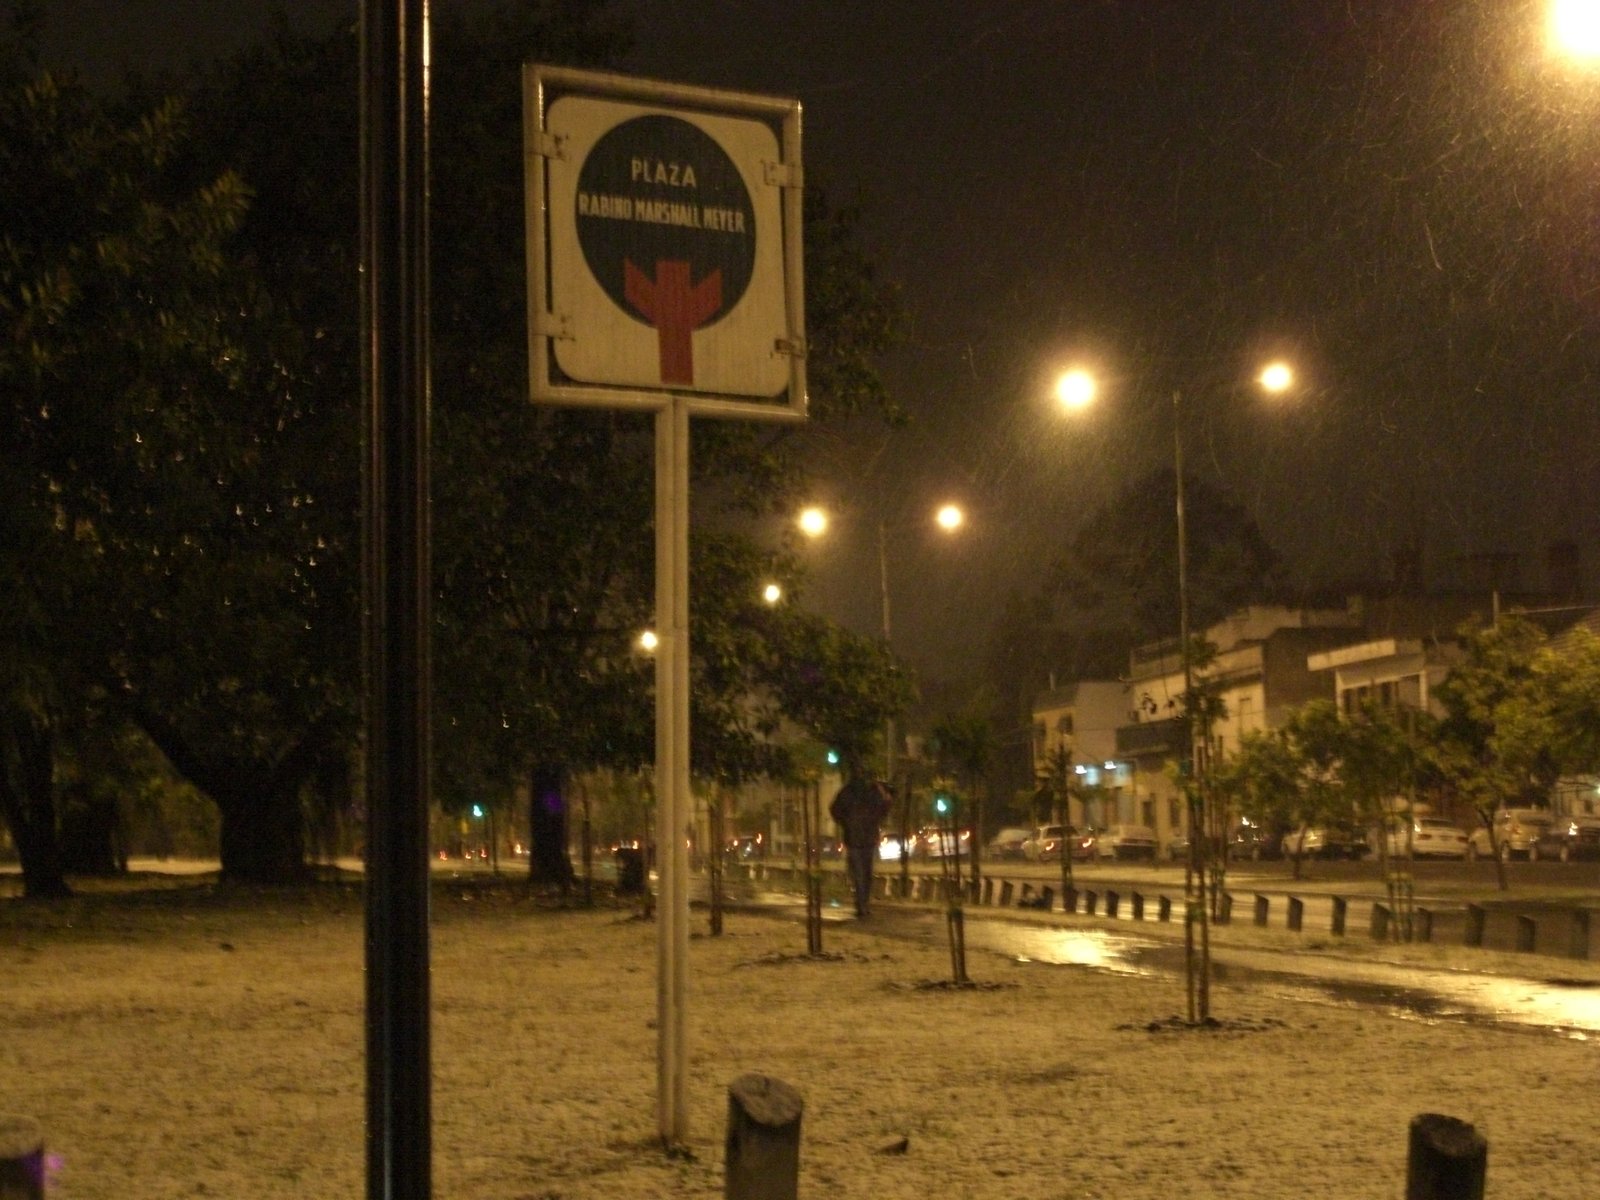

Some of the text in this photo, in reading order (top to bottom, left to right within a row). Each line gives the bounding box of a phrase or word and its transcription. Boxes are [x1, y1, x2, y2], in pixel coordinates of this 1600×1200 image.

[631, 159, 697, 188] PLAZA
[577, 192, 745, 233] RABINO MARSHALL MEYER
